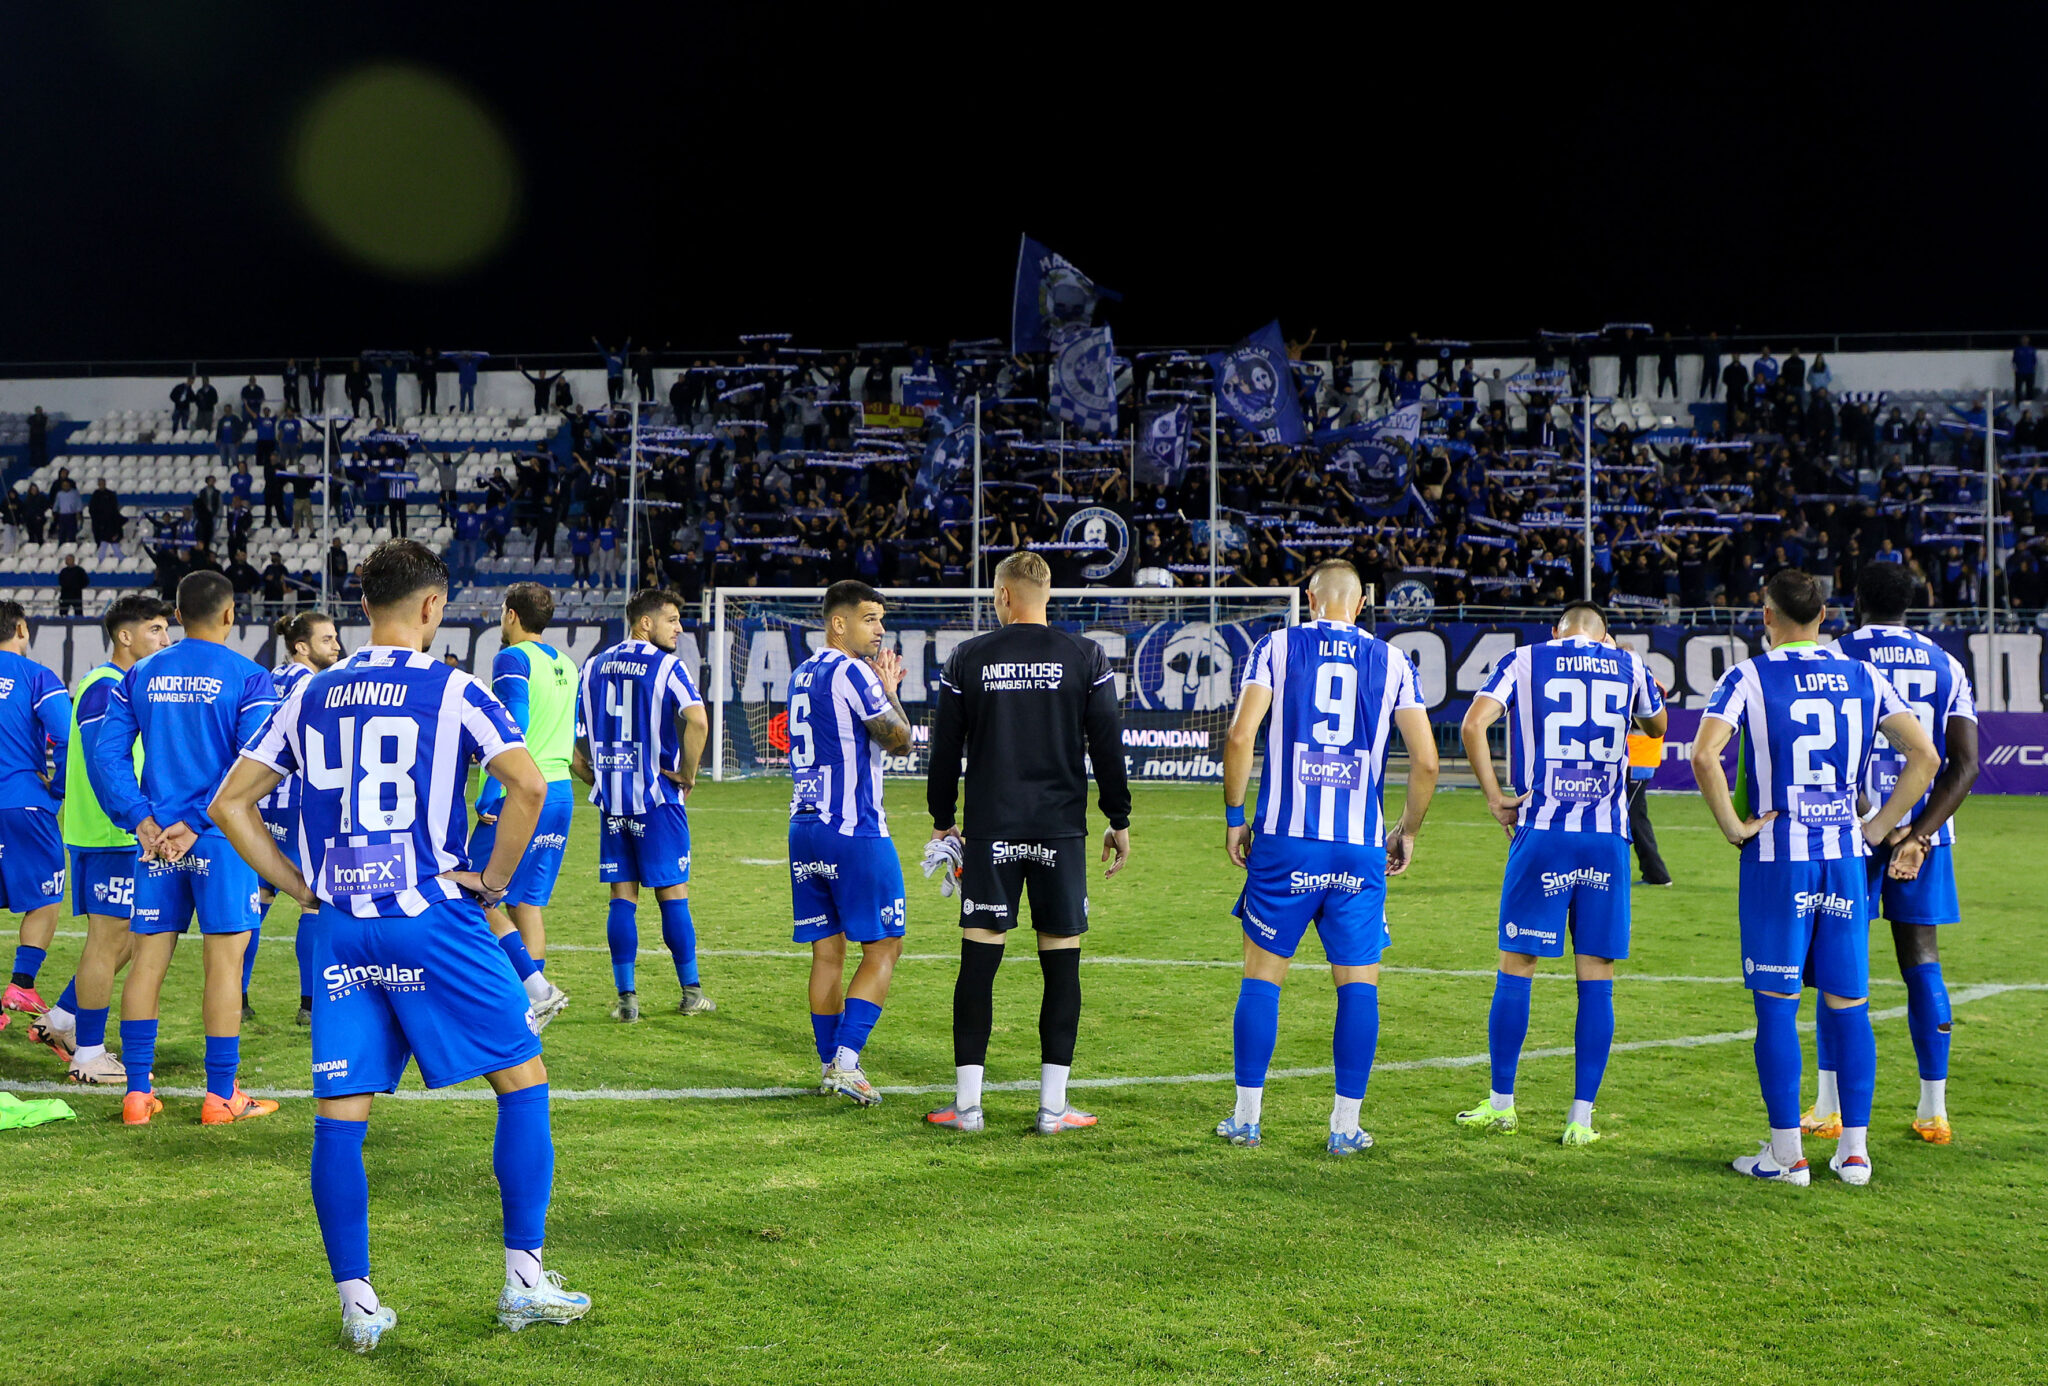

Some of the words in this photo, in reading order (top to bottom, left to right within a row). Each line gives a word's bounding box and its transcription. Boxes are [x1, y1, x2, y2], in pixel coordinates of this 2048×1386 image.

[1319, 640, 1357, 659] ILIEV
[1869, 646, 1931, 666] MUGABI
[600, 661, 648, 676] ARTYMATAS
[982, 663, 1063, 681] ANORTHOSIS
[1556, 656, 1619, 675] GYURCSO
[147, 676, 223, 695] ANORTHOSIS
[984, 680, 1032, 692] FAMAGUSTA
[1034, 679, 1046, 689] FC
[1794, 674, 1849, 692] LOPES
[324, 681, 407, 709] IOANNOU
[1312, 662, 1358, 747] 9
[606, 680, 633, 741] 4
[1544, 678, 1628, 763] 25
[790, 693, 815, 767] 5
[1122, 728, 1209, 748] AMONDANI
[1790, 698, 1863, 785] 21
[598, 751, 634, 765] IronFX
[1143, 755, 1224, 777] novibe
[305, 716, 420, 833] 48
[1302, 759, 1353, 780] IronFX
[1555, 775, 1602, 794] IronFX
[1801, 798, 1850, 818] IronFX
[991, 841, 1057, 861] Singular
[53, 869, 65, 894] 17
[334, 860, 396, 883] IronFX
[1290, 871, 1365, 890] Singular
[1540, 867, 1612, 889] Singular
[108, 877, 135, 905] 52
[356, 881, 395, 890] TRADING
[894, 898, 905, 927] 5
[323, 963, 424, 990] Singular
[329, 988, 351, 1002] B2B
[356, 983, 367, 992] IT
[327, 1070, 348, 1081] group
